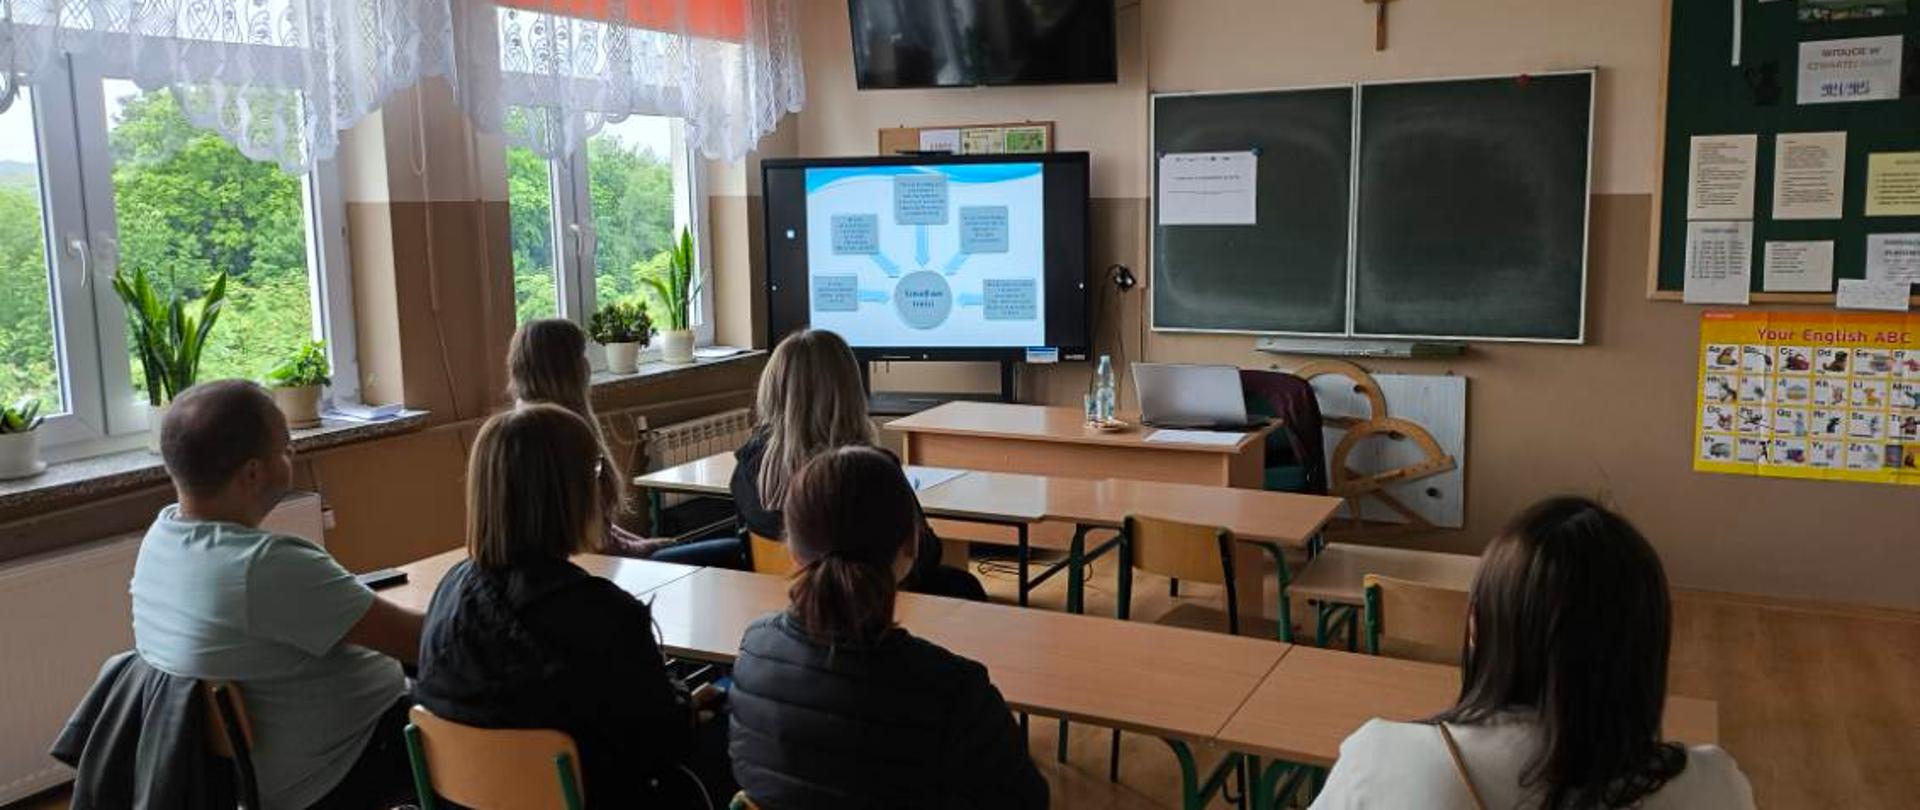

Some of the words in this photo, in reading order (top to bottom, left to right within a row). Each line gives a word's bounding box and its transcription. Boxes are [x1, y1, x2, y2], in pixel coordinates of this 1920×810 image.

[1758, 328, 1794, 340] Your
[1803, 329, 1867, 344] English
[1874, 331, 1911, 343] ABC
